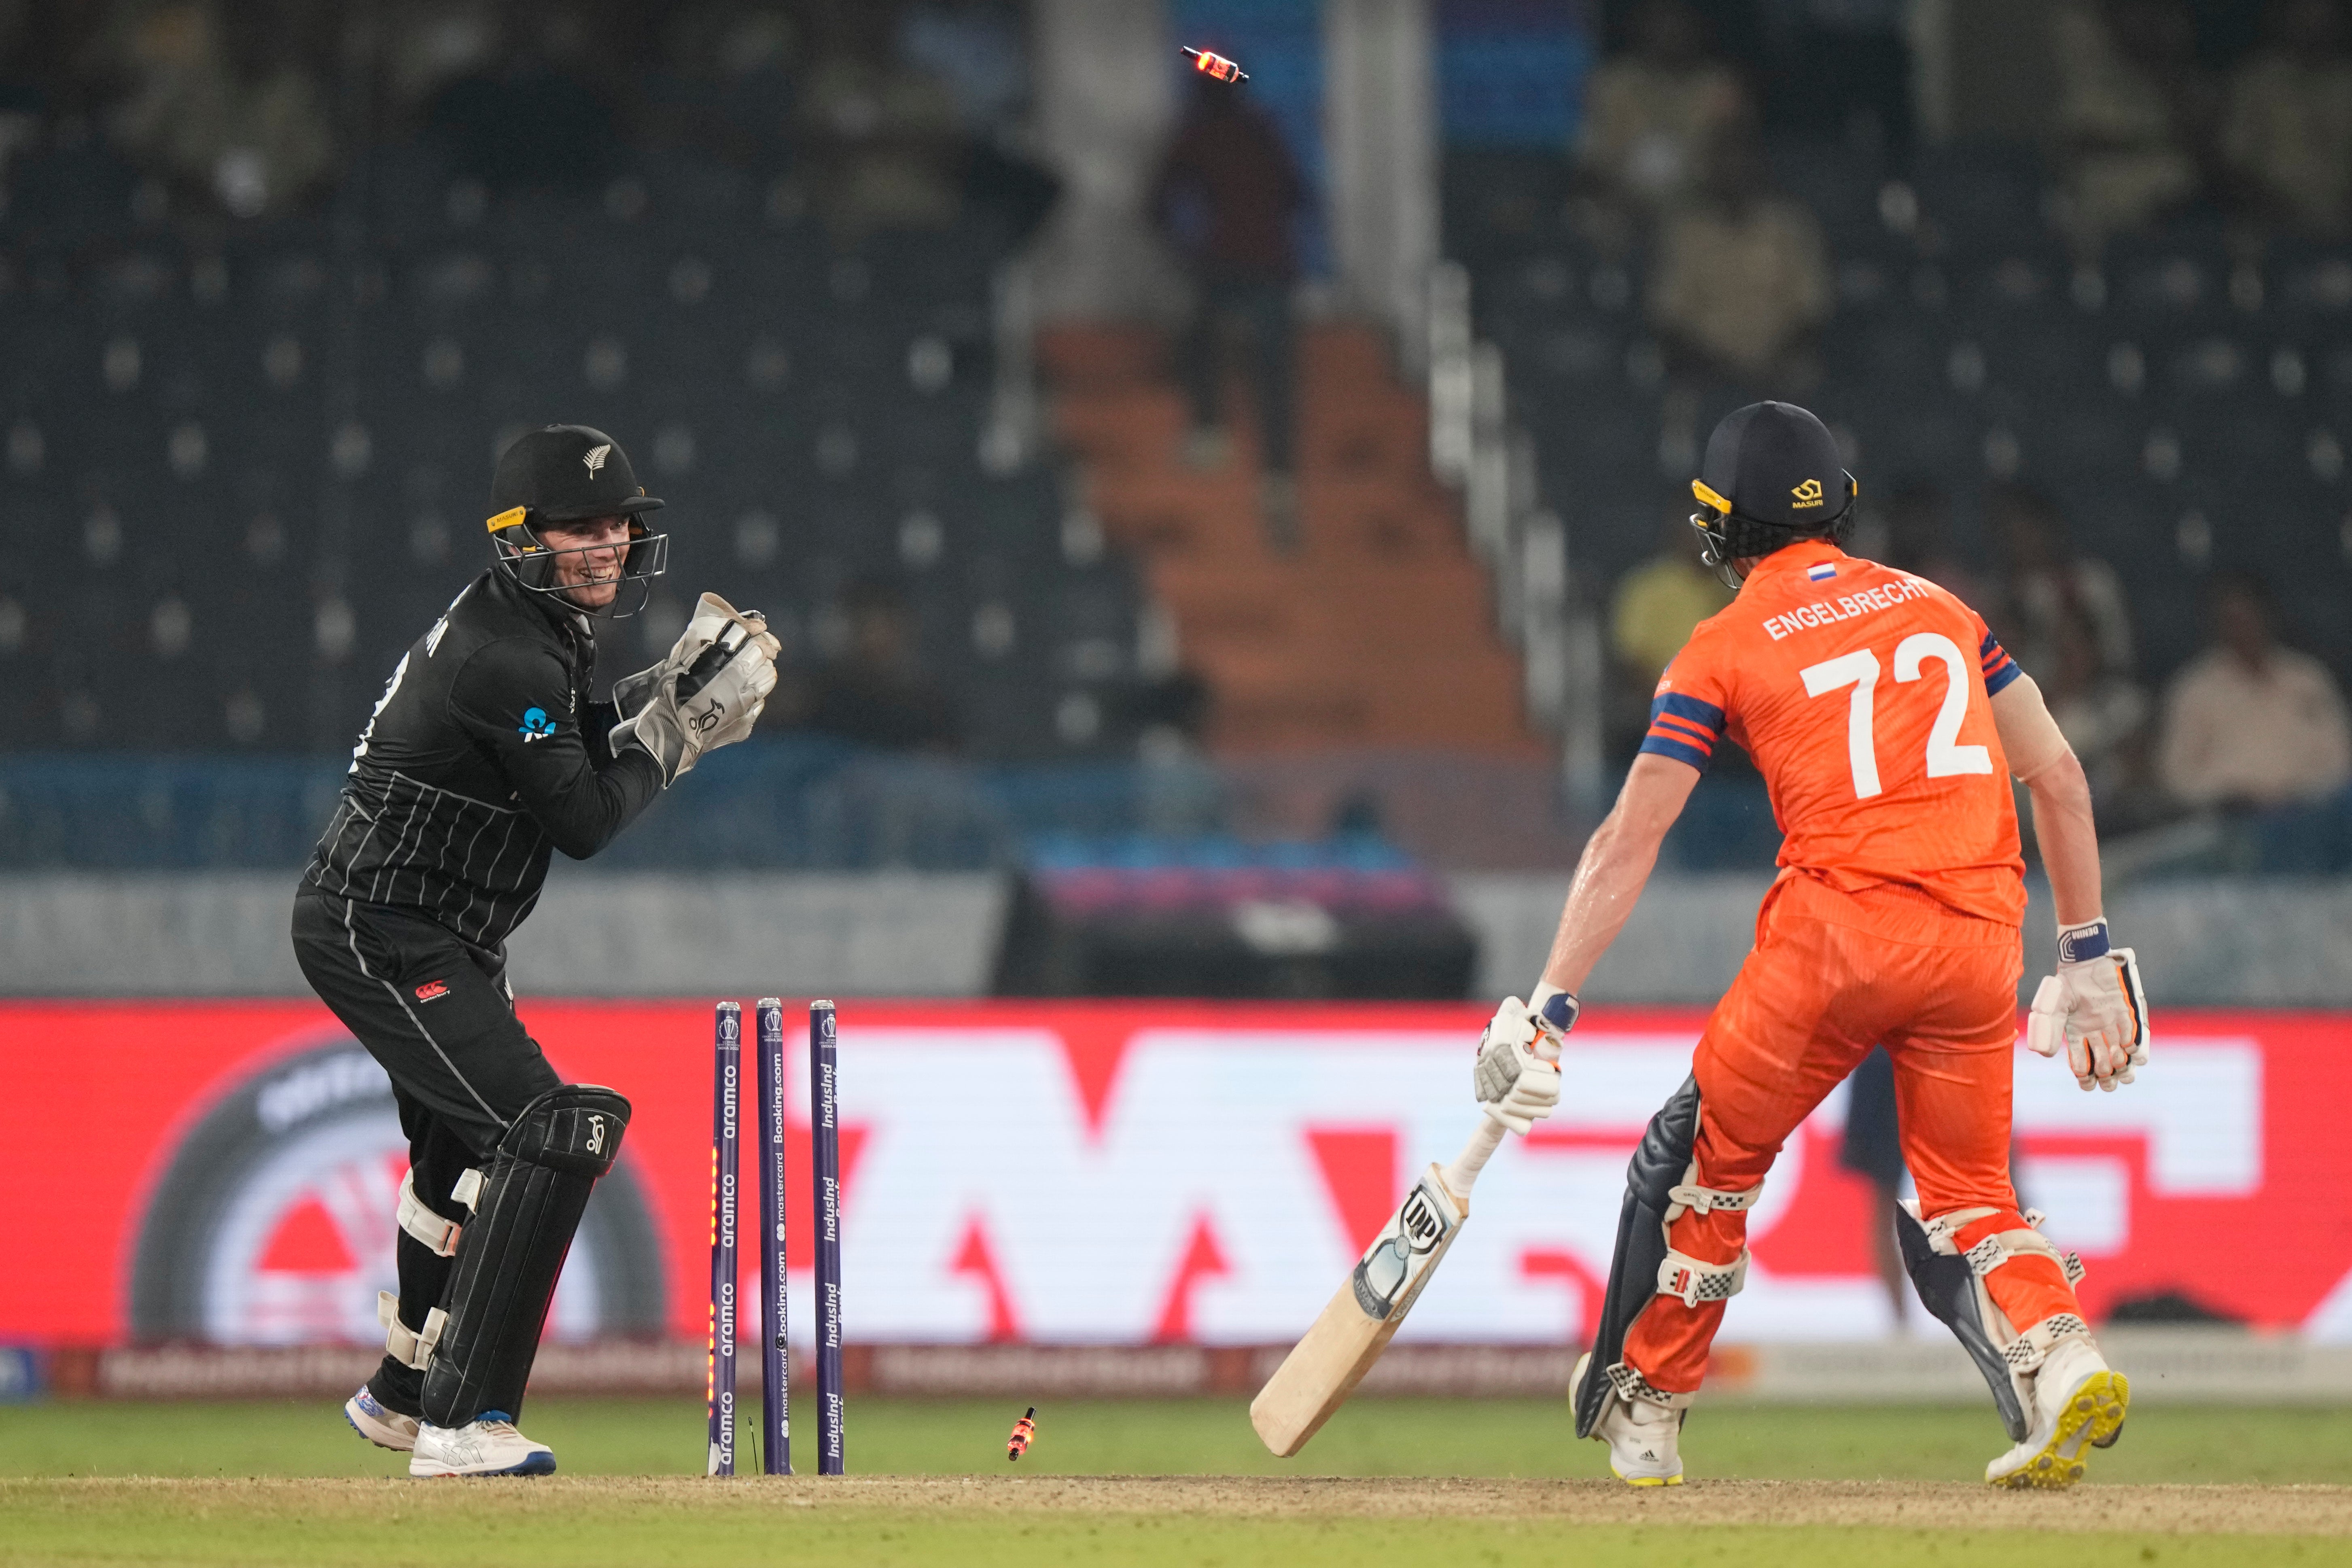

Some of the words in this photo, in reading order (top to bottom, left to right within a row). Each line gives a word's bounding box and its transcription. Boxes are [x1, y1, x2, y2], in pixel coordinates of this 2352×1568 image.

[497, 512, 518, 522] MASURI
[1792, 499, 1823, 509] MASURI
[1762, 579, 1929, 641] ENGELBRECHT
[1799, 632, 1993, 799] 72
[2071, 925, 2099, 940] DENIM
[420, 990, 450, 1004] canterbury
[723, 1065, 736, 1139] aramco
[772, 1053, 783, 1143] Booking.com
[820, 1063, 833, 1129] IndusInd
[722, 1174, 735, 1248] aramco
[775, 1152, 784, 1221] mastercard
[823, 1176, 836, 1242] IndusInd
[721, 1283, 734, 1357] aramco
[776, 1251, 787, 1342] Booking.com
[825, 1282, 838, 1348] IndusInd
[778, 1348, 789, 1417] mastercard
[720, 1392, 733, 1465] aramco
[826, 1392, 839, 1458] IndusInd
